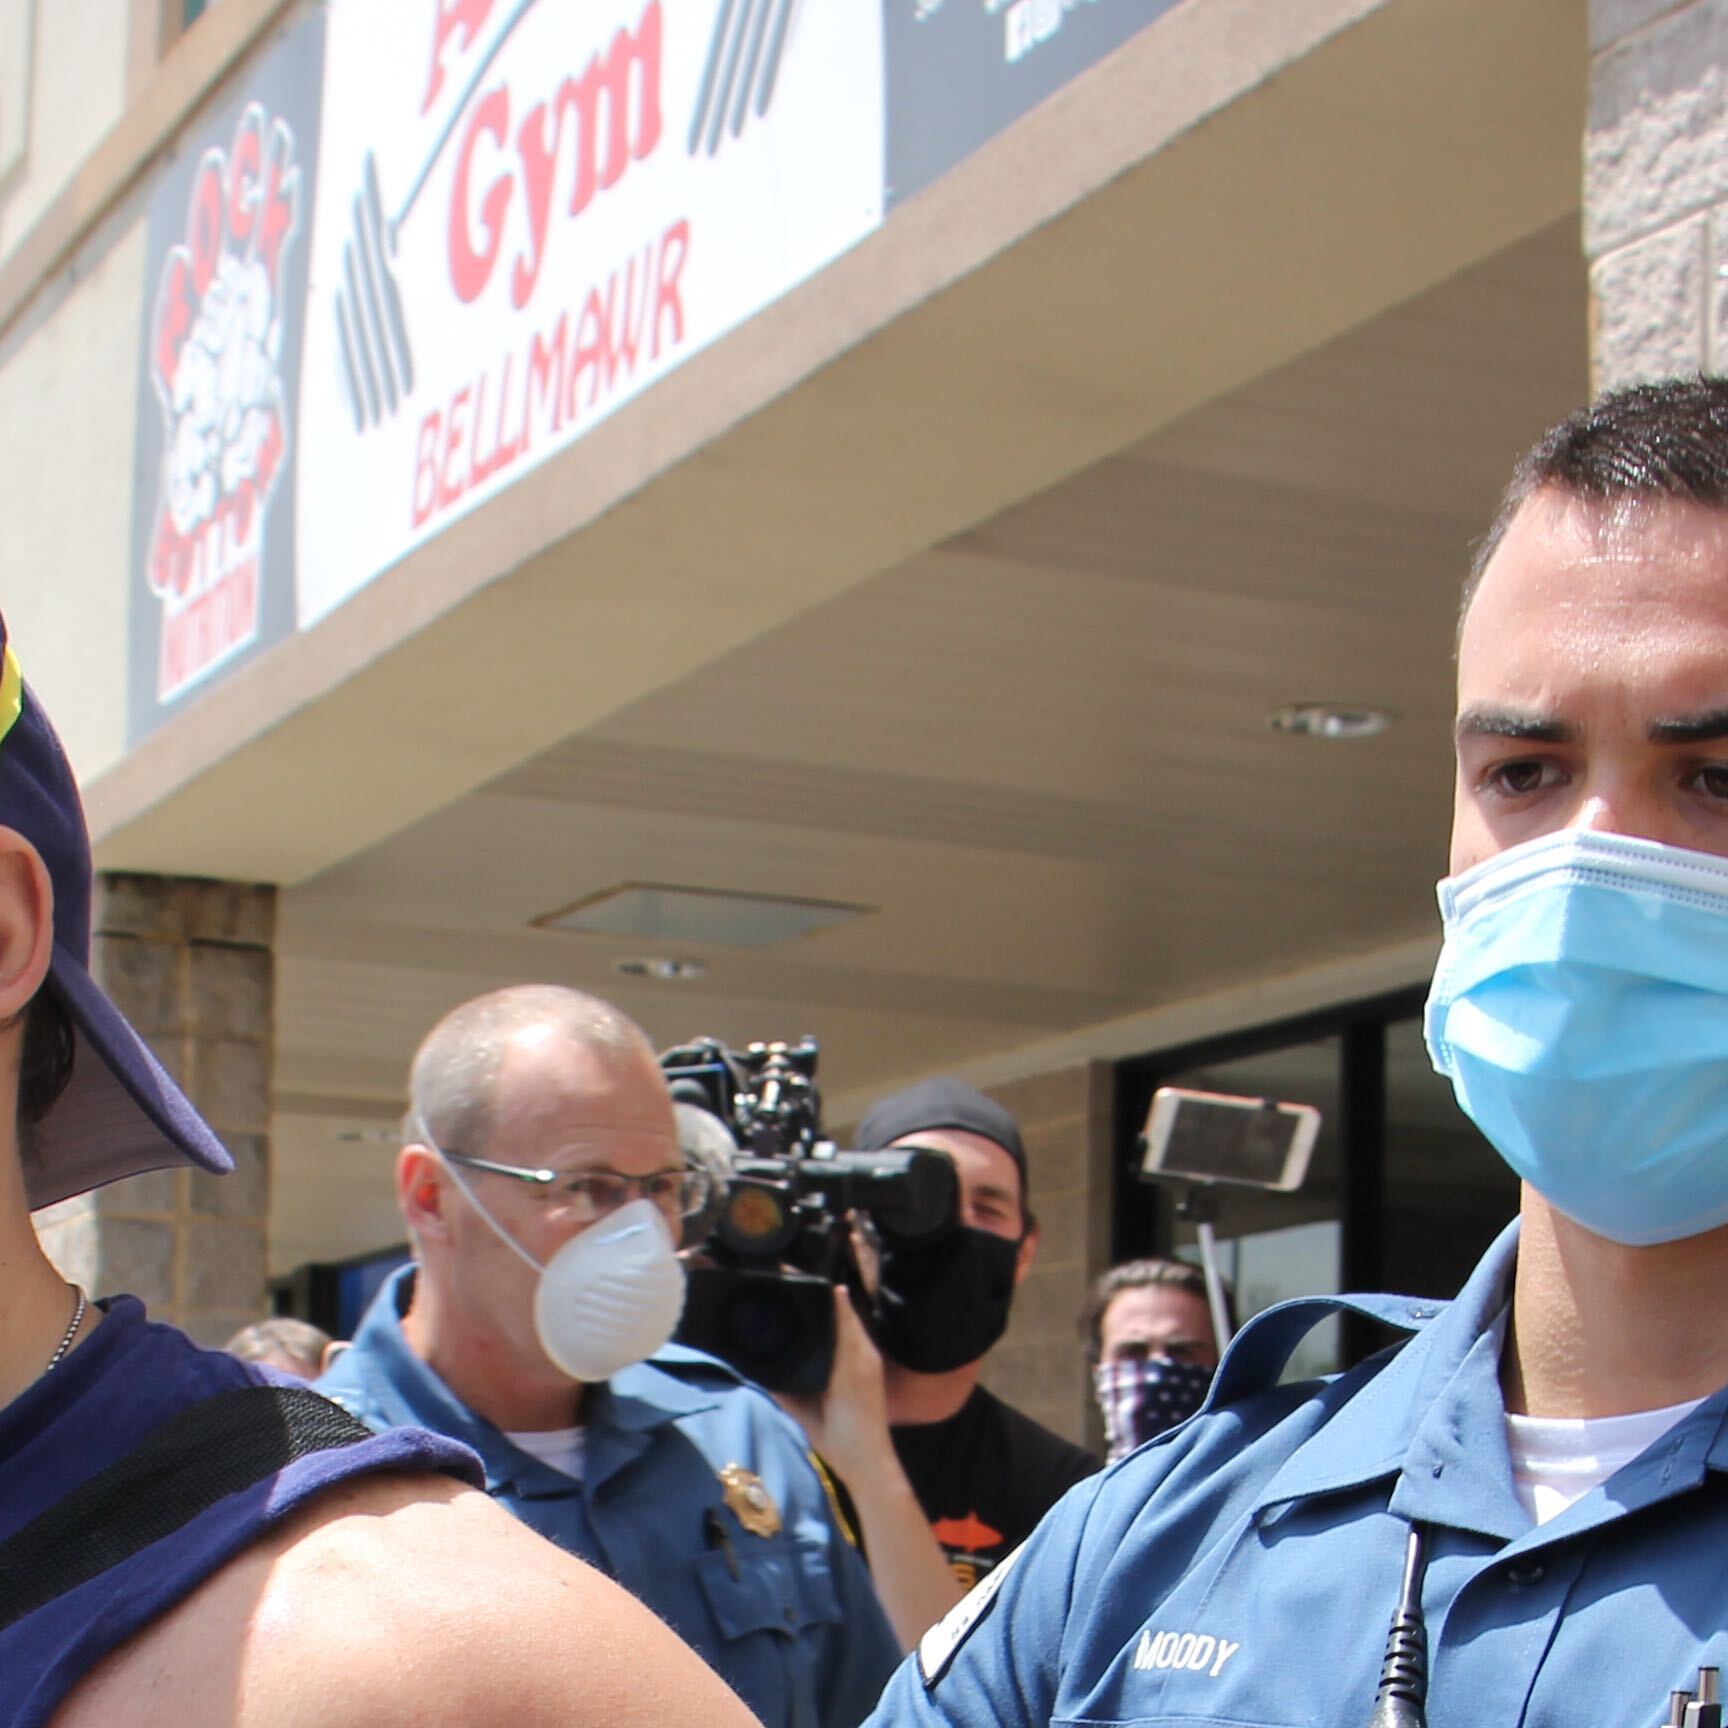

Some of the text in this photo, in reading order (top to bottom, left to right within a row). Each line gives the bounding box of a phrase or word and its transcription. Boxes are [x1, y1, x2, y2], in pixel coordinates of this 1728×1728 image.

[448, 0, 663, 311] Gym
[411, 217, 690, 531] BELLMAWR
[1134, 1629, 1240, 1677] MOODY
